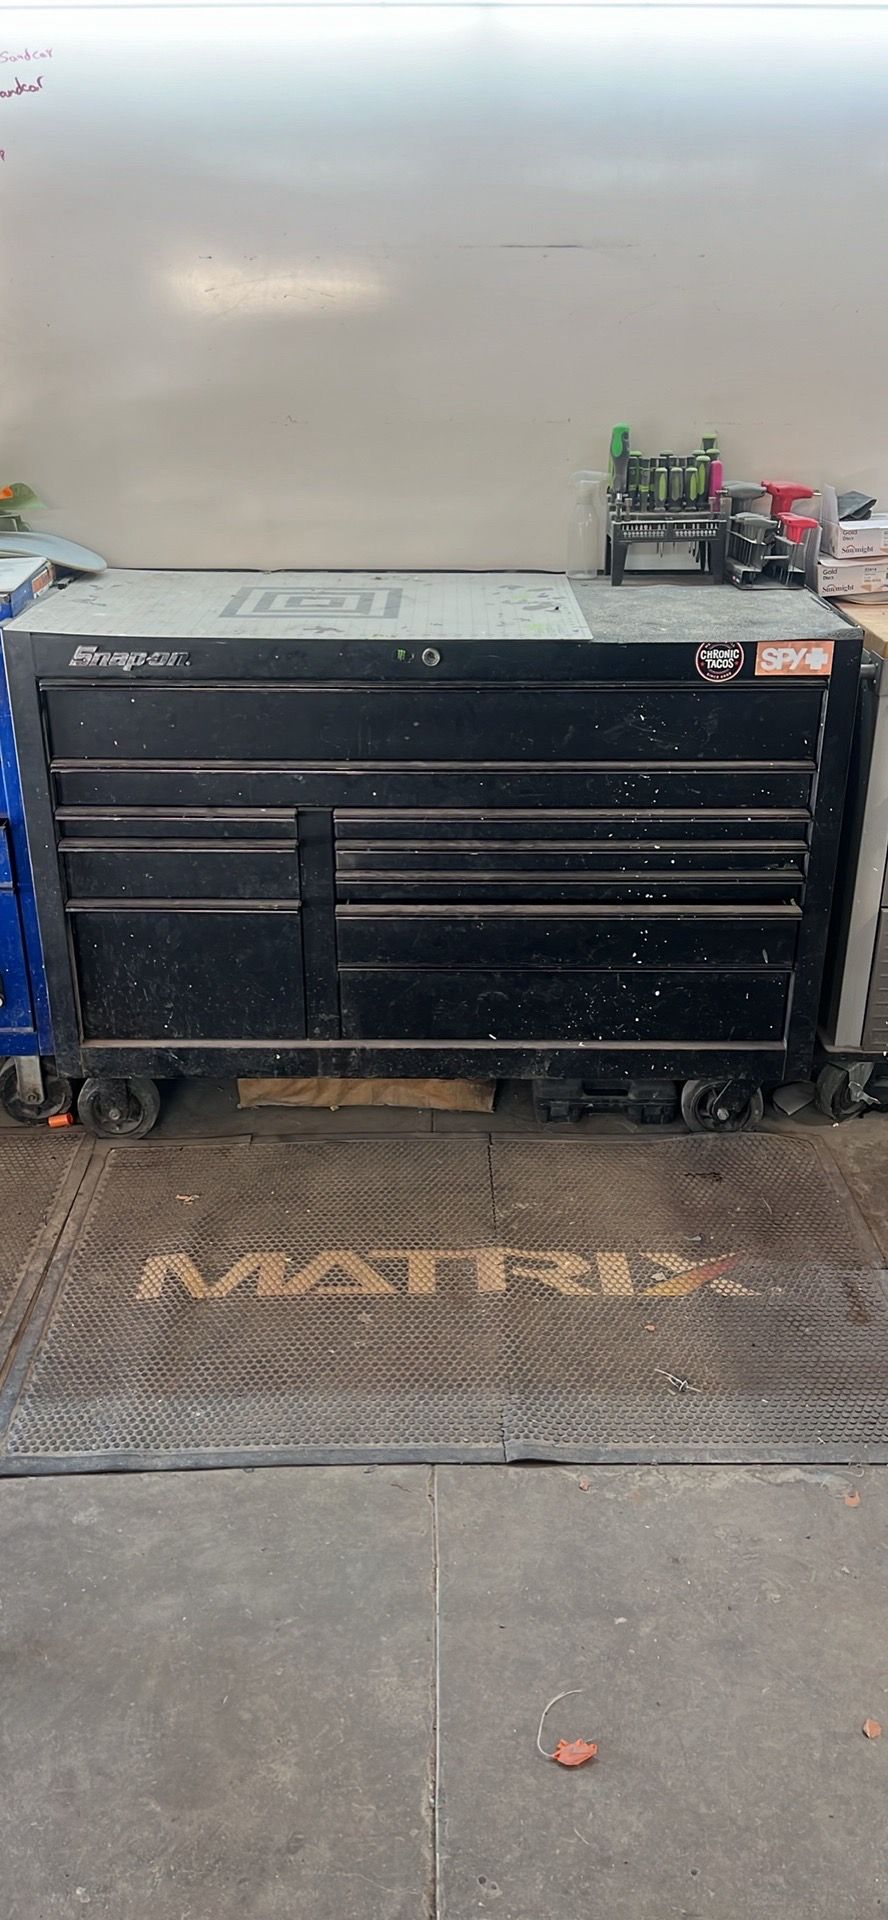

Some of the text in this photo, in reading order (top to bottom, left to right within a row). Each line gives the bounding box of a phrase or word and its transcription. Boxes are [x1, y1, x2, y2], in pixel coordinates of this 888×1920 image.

[700, 649, 740, 660] CHRONIC
[705, 658, 735, 669] TACOS
[135, 1247, 762, 1300] MATRIX
